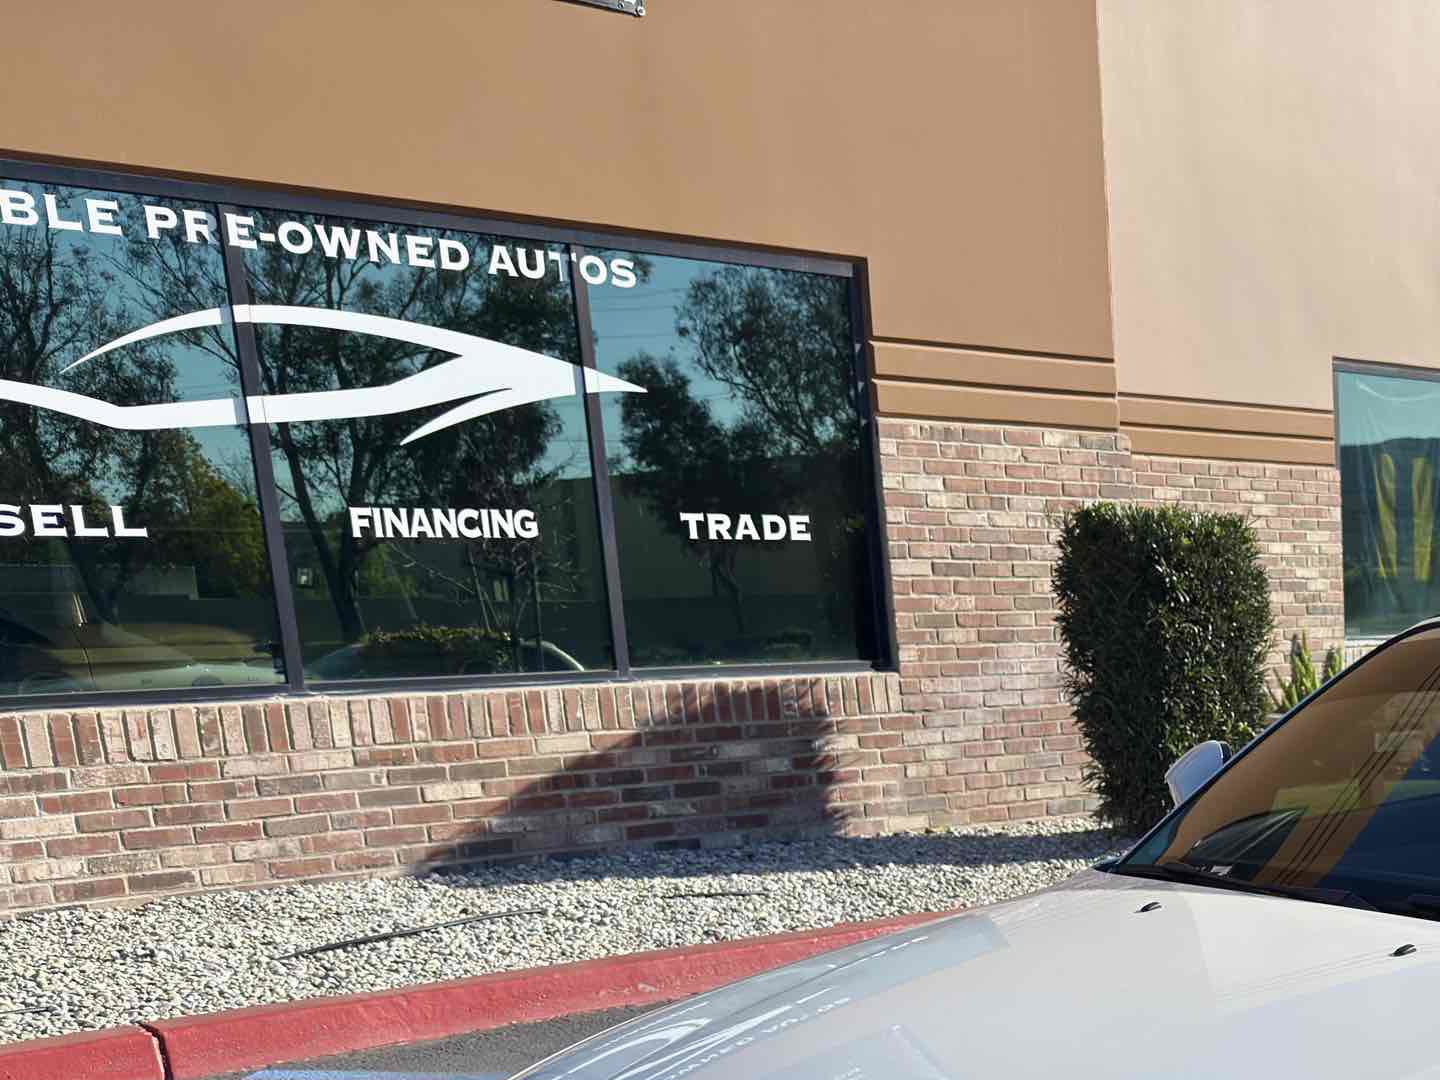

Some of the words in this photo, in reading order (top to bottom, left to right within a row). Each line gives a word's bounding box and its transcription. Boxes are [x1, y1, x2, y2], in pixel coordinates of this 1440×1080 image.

[0, 189, 123, 237] BLE
[143, 204, 470, 271] PRE-OWNED
[488, 244, 637, 288] AUTOS
[0, 503, 148, 538] SELL
[349, 506, 540, 539] FINANCING
[679, 511, 812, 542] TRADE
